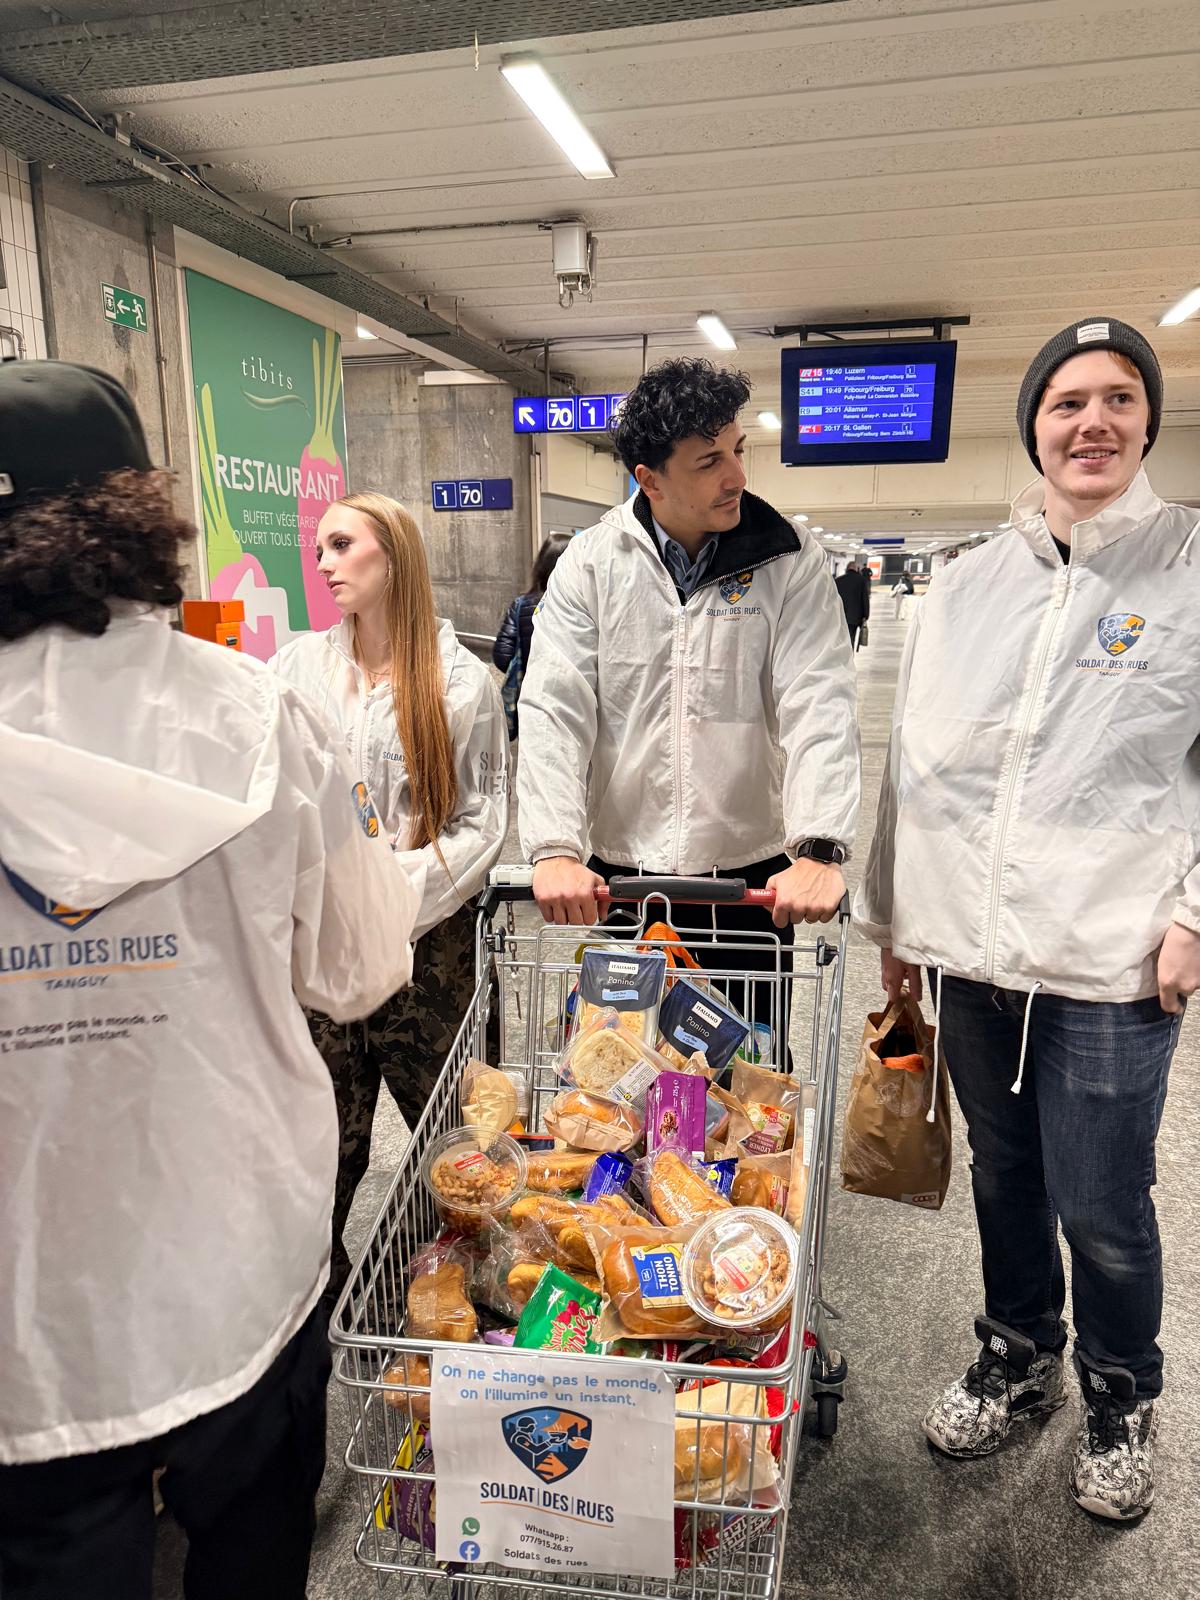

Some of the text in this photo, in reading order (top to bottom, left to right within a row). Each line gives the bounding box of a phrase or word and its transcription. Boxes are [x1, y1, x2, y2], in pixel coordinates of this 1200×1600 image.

[241, 356, 293, 390] tibits
[800, 388, 815, 396] S41
[844, 385, 895, 394] Fribourg/Freiburg
[550, 407, 596, 427] 70 1
[214, 453, 339, 502] RESTAURANT
[441, 490, 481, 505] 1 70
[243, 509, 274, 527] BUFFET
[233, 529, 267, 545] OUVERT
[270, 531, 292, 547] TOUS
[294, 533, 308, 548] LES
[706, 606, 761, 617] SOLDAT DES RUES
[1076, 659, 1149, 671] SOLDAT DES RUES
[0, 933, 178, 971] LDAT DES RUES
[611, 963, 637, 972] ITALIAMO
[45, 974, 110, 991] TANGUY
[607, 975, 635, 986] Panino
[695, 1004, 719, 1025] ITALIAMO
[16, 1023, 65, 1036] change
[67, 1019, 89, 1032] pas
[91, 1017, 103, 1027] le
[152, 1013, 169, 1024] on
[686, 1015, 710, 1038] Panino
[654, 1260, 665, 1289] THON
[663, 1256, 679, 1292] TONNO
[441, 1365, 661, 1394] On ne change pas le monde,
[460, 1387, 636, 1406] on l'illumine un instant.
[480, 1482, 614, 1523] SOLDAT DES RUES
[525, 1523, 565, 1542] Whatsapp
[520, 1534, 574, 1553] 077/915.26.87
[504, 1548, 588, 1567] Soldats des rues
